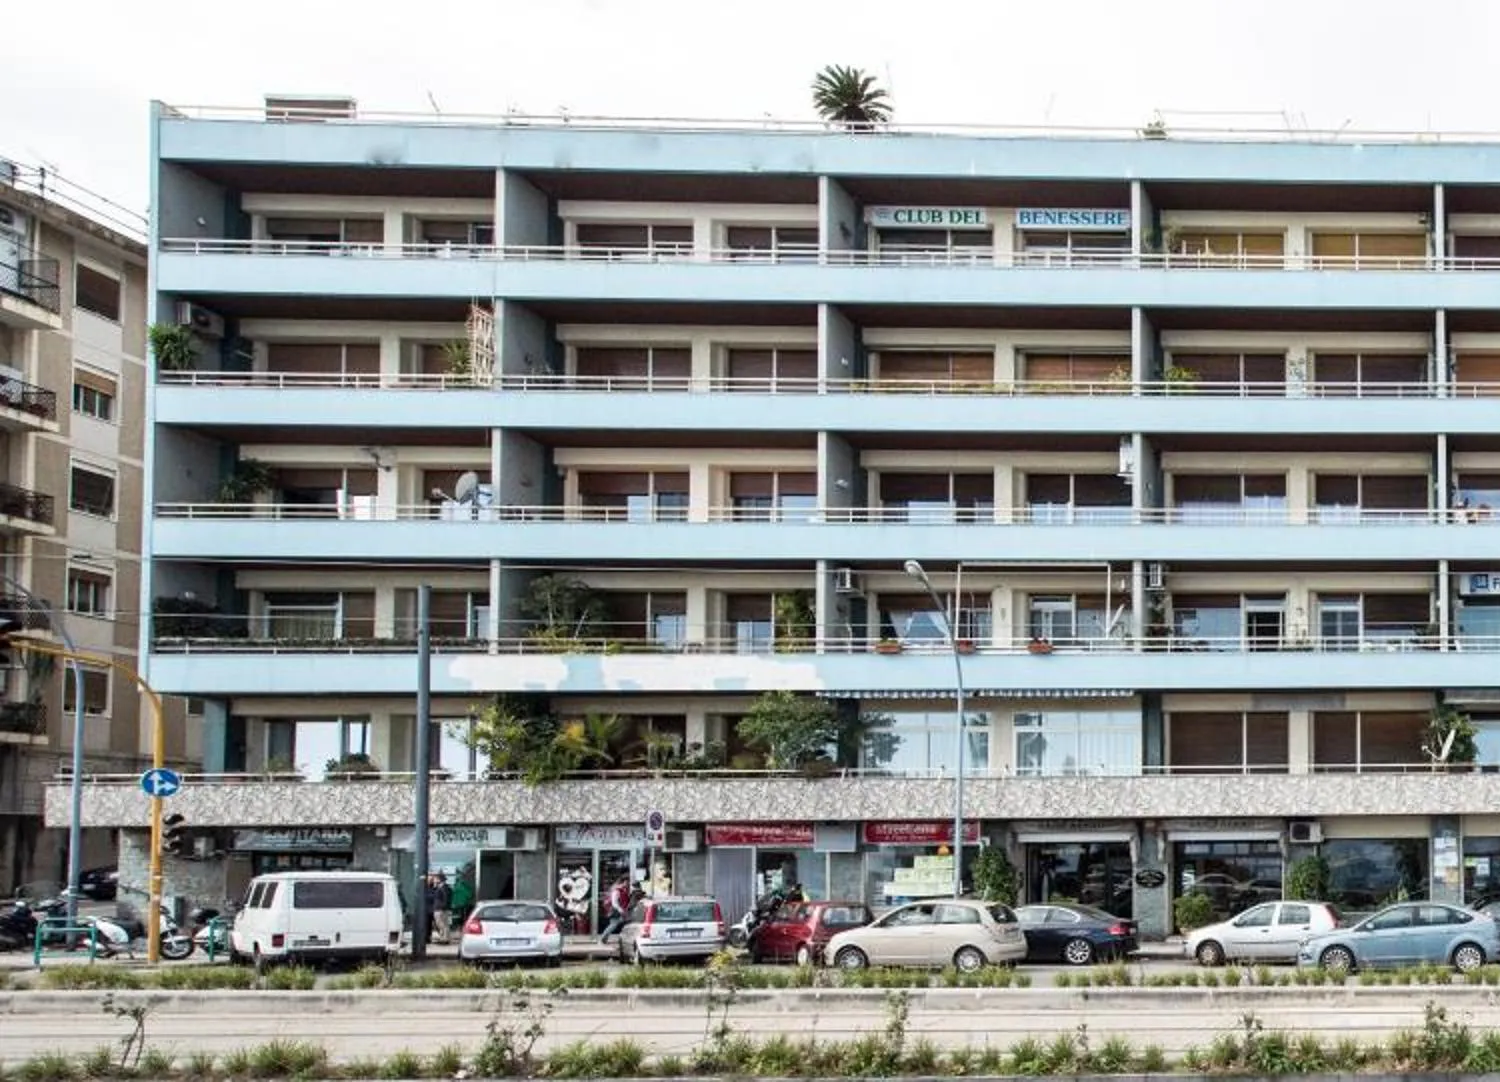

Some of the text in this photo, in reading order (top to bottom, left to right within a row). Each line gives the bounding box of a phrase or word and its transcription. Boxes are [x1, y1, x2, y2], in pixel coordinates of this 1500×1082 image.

[894, 209, 1128, 225] CLUB DEL BENESSERE
